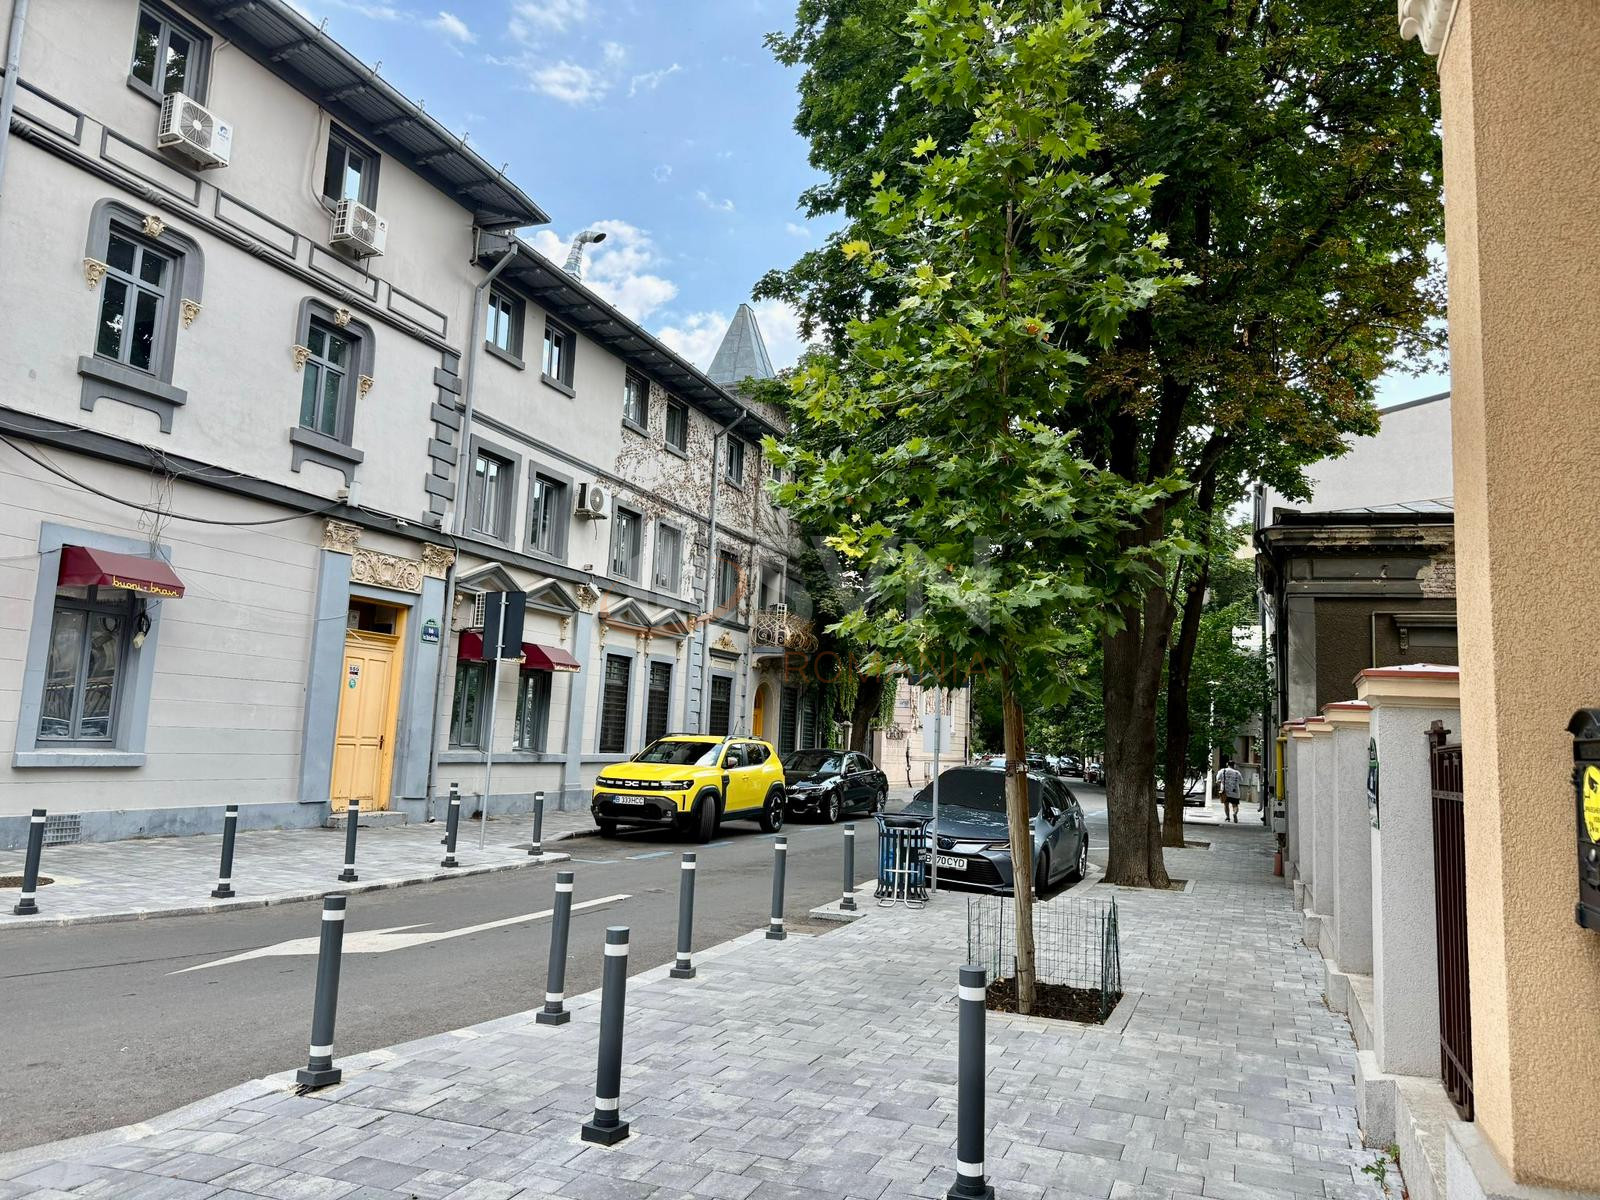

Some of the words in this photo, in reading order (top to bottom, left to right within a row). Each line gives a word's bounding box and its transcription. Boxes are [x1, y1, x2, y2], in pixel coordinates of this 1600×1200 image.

[113, 575, 142, 591] buoni
[150, 582, 180, 597] bravi
[936, 855, 965, 868] 70CYD
